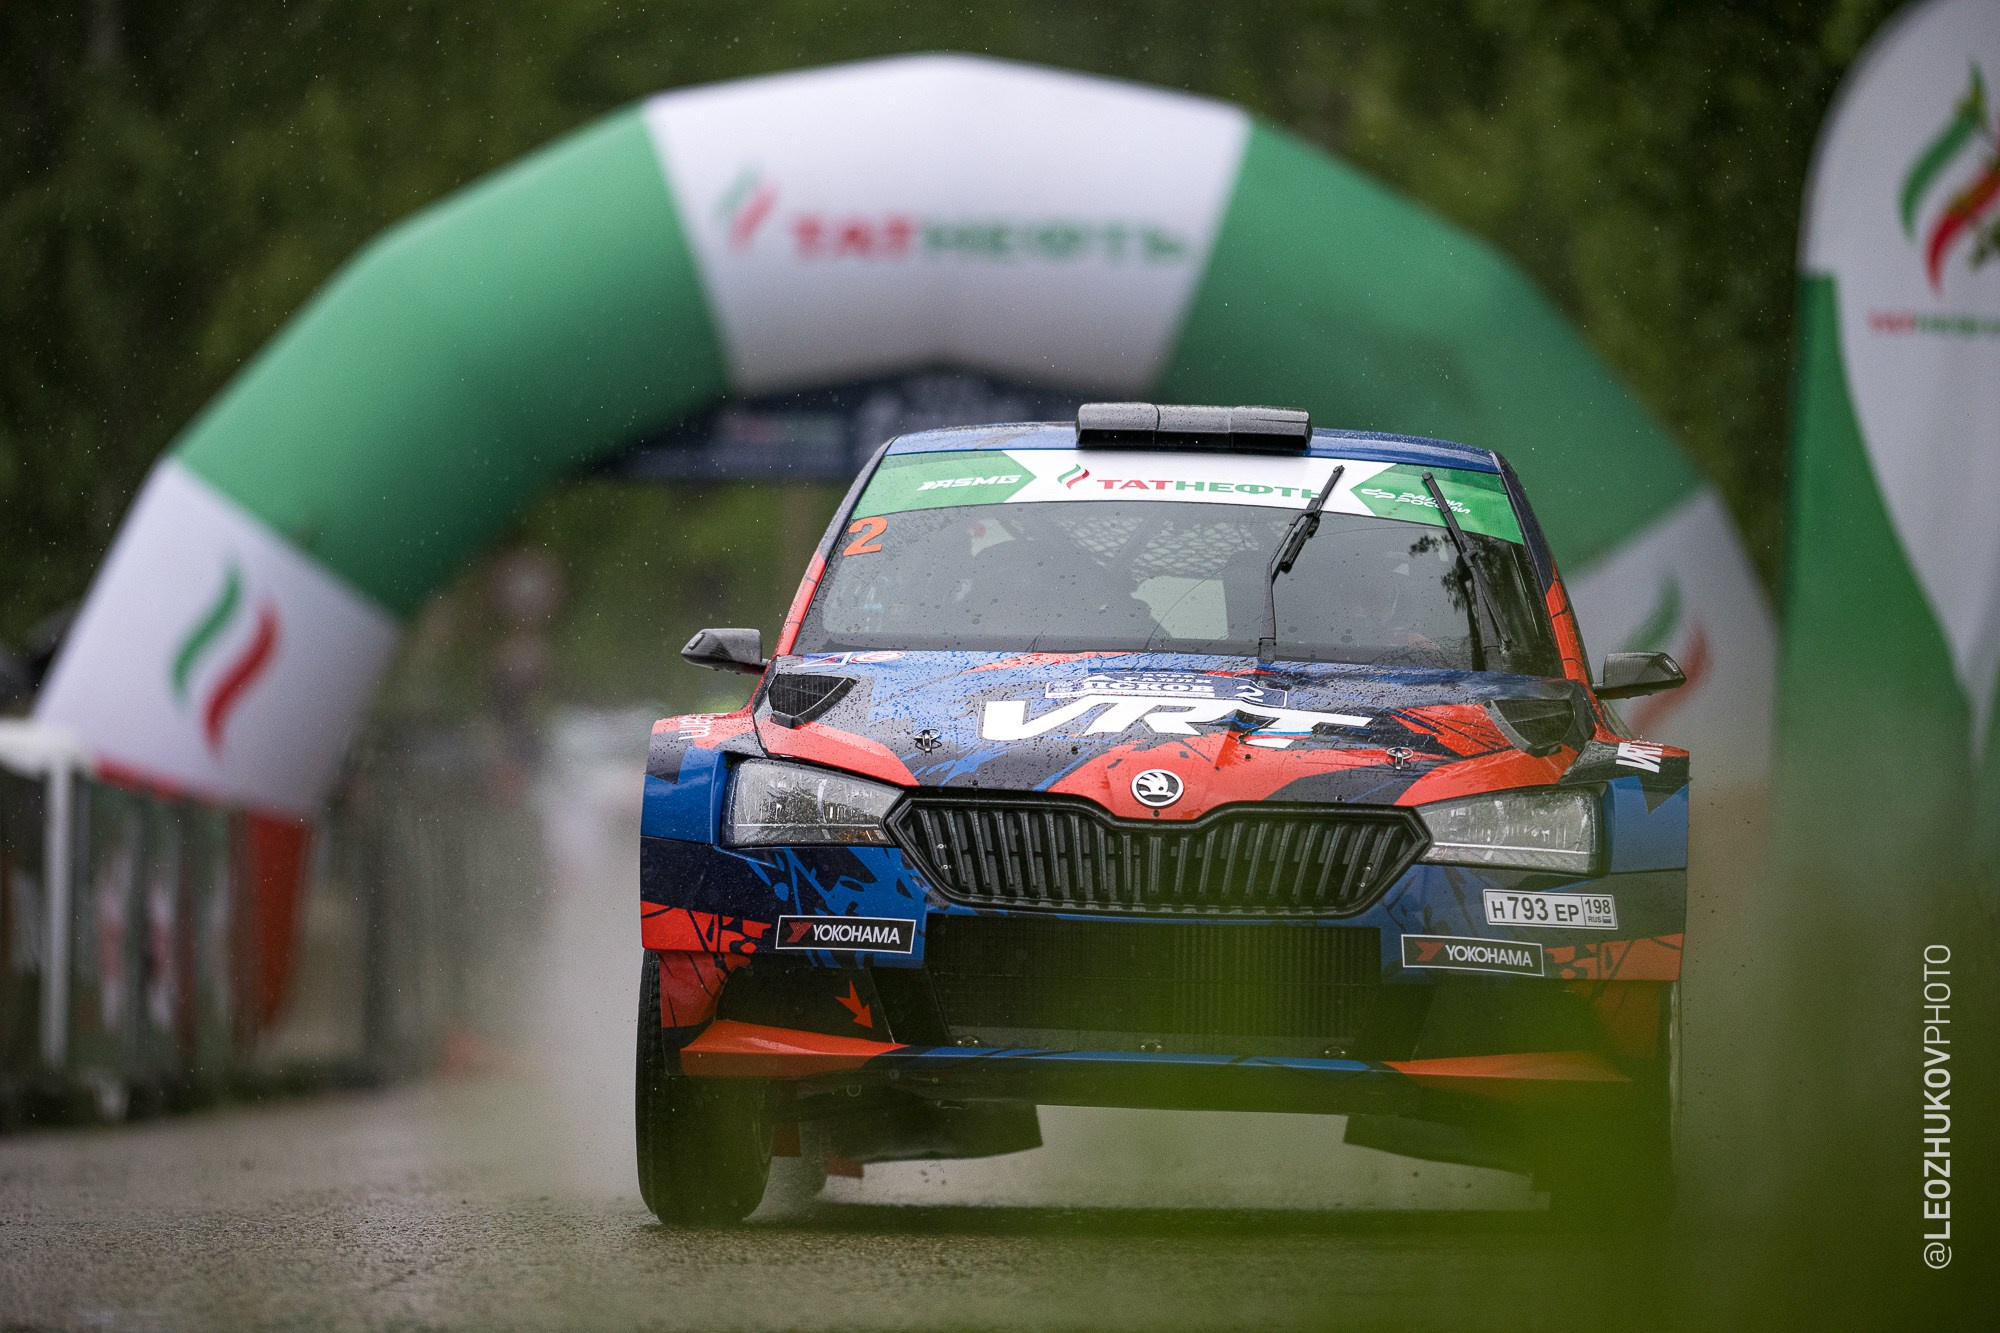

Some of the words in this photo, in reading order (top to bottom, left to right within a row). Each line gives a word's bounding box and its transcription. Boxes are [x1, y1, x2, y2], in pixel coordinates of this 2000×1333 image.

[1096, 479, 1322, 499] ТАТНЕФТЬ
[842, 516, 888, 557] 2
[1084, 681, 1215, 692] ПСКОВ
[1235, 685, 1265, 702] 2
[982, 695, 1373, 749] VRT
[1584, 898, 1611, 915] 198
[1587, 915, 1602, 923] RUS
[813, 924, 901, 945] YOKOHAMA
[1445, 944, 1534, 967] YOKOHAMA
